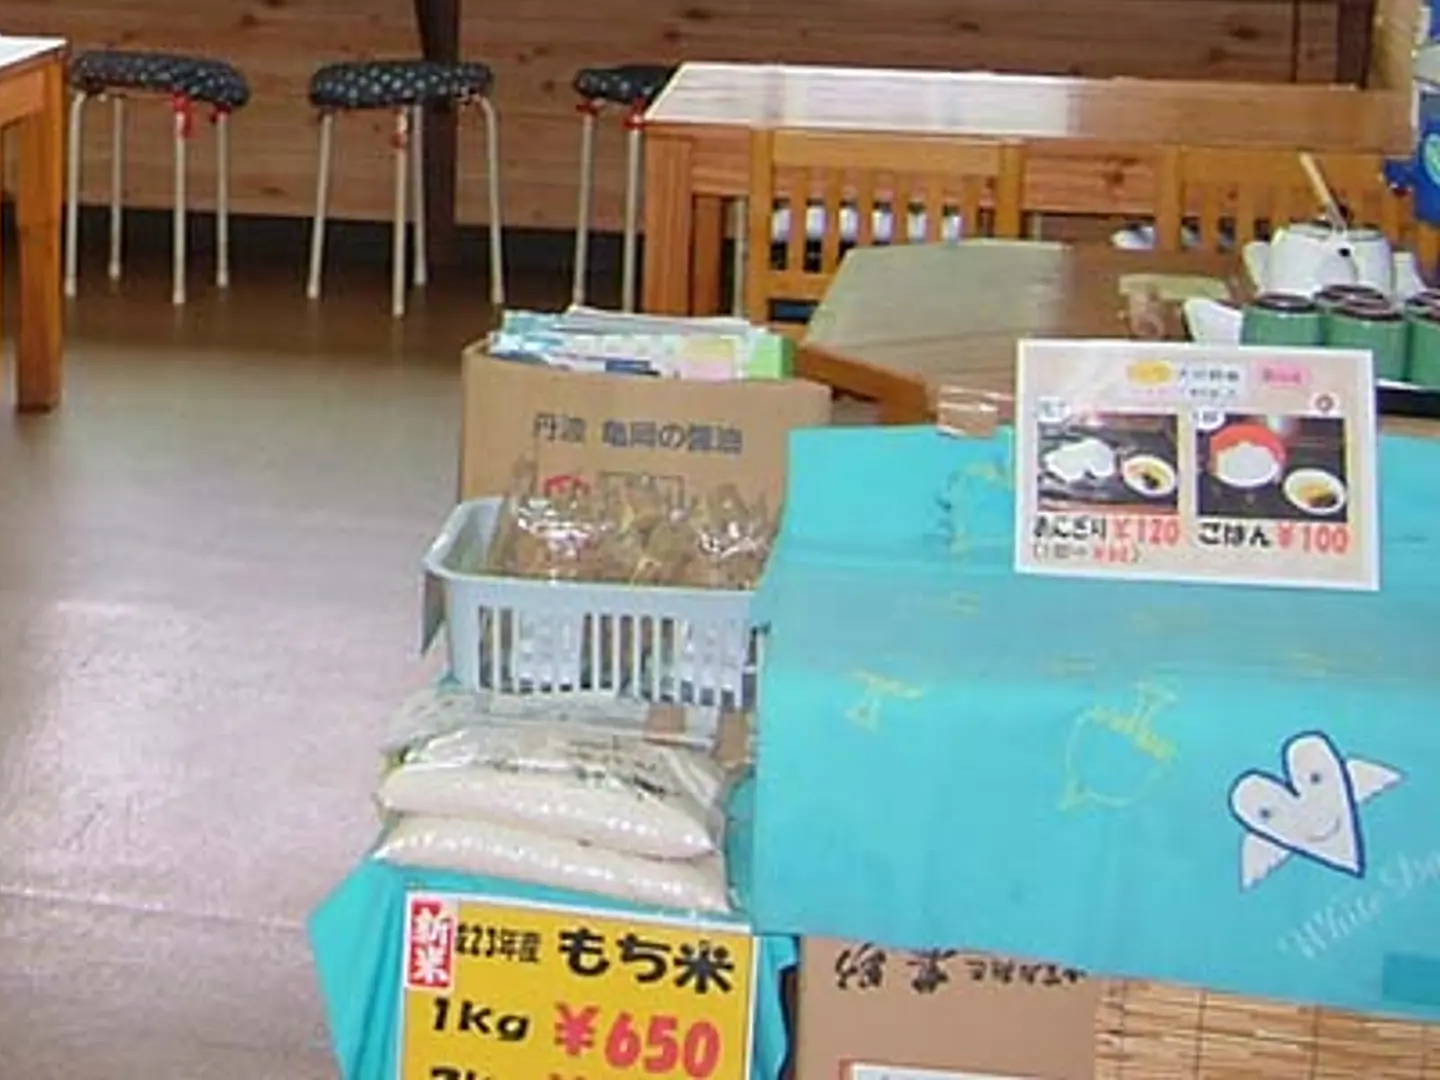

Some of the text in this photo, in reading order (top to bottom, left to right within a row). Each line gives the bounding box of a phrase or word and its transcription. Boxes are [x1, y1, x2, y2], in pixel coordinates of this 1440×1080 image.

[1197, 522, 1271, 548] ごはん
[411, 907, 452, 985] 新米
[558, 927, 735, 995] もち米
[432, 996, 722, 1079] 1kg ¥650
